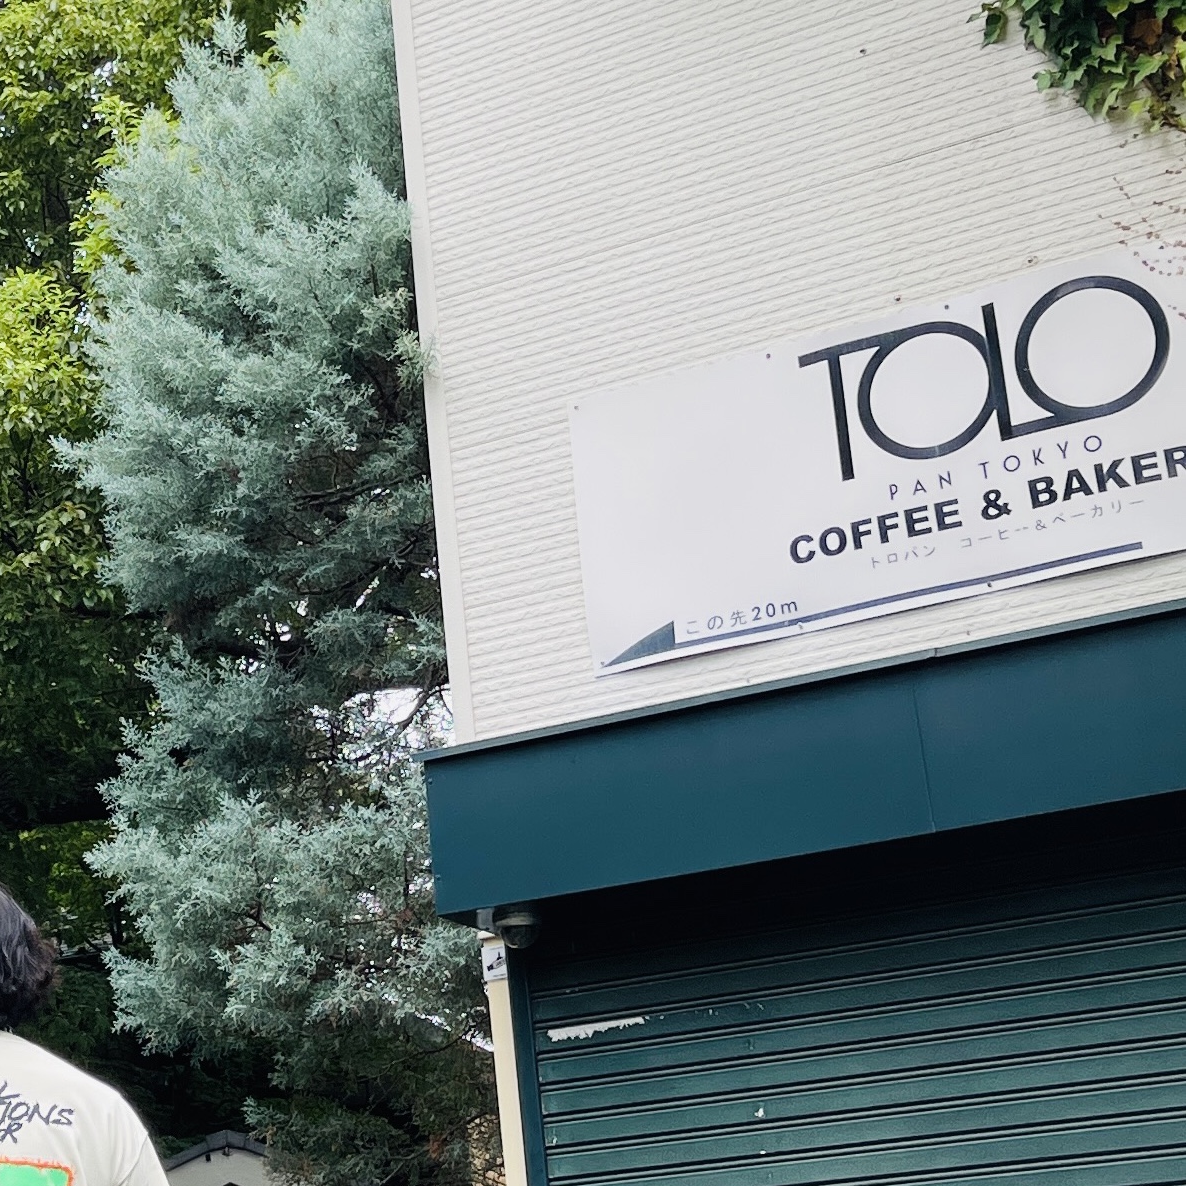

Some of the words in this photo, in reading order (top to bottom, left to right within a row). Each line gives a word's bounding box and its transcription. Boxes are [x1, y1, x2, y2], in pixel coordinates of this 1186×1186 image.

[798, 275, 1170, 481] TOLO
[889, 470, 953, 500] PAN
[978, 435, 1103, 480] TOKYO
[789, 498, 963, 564] COFFEE
[980, 488, 1012, 521] &
[870, 545, 936, 569] トロパン
[686, 600, 799, 635] この先20m
